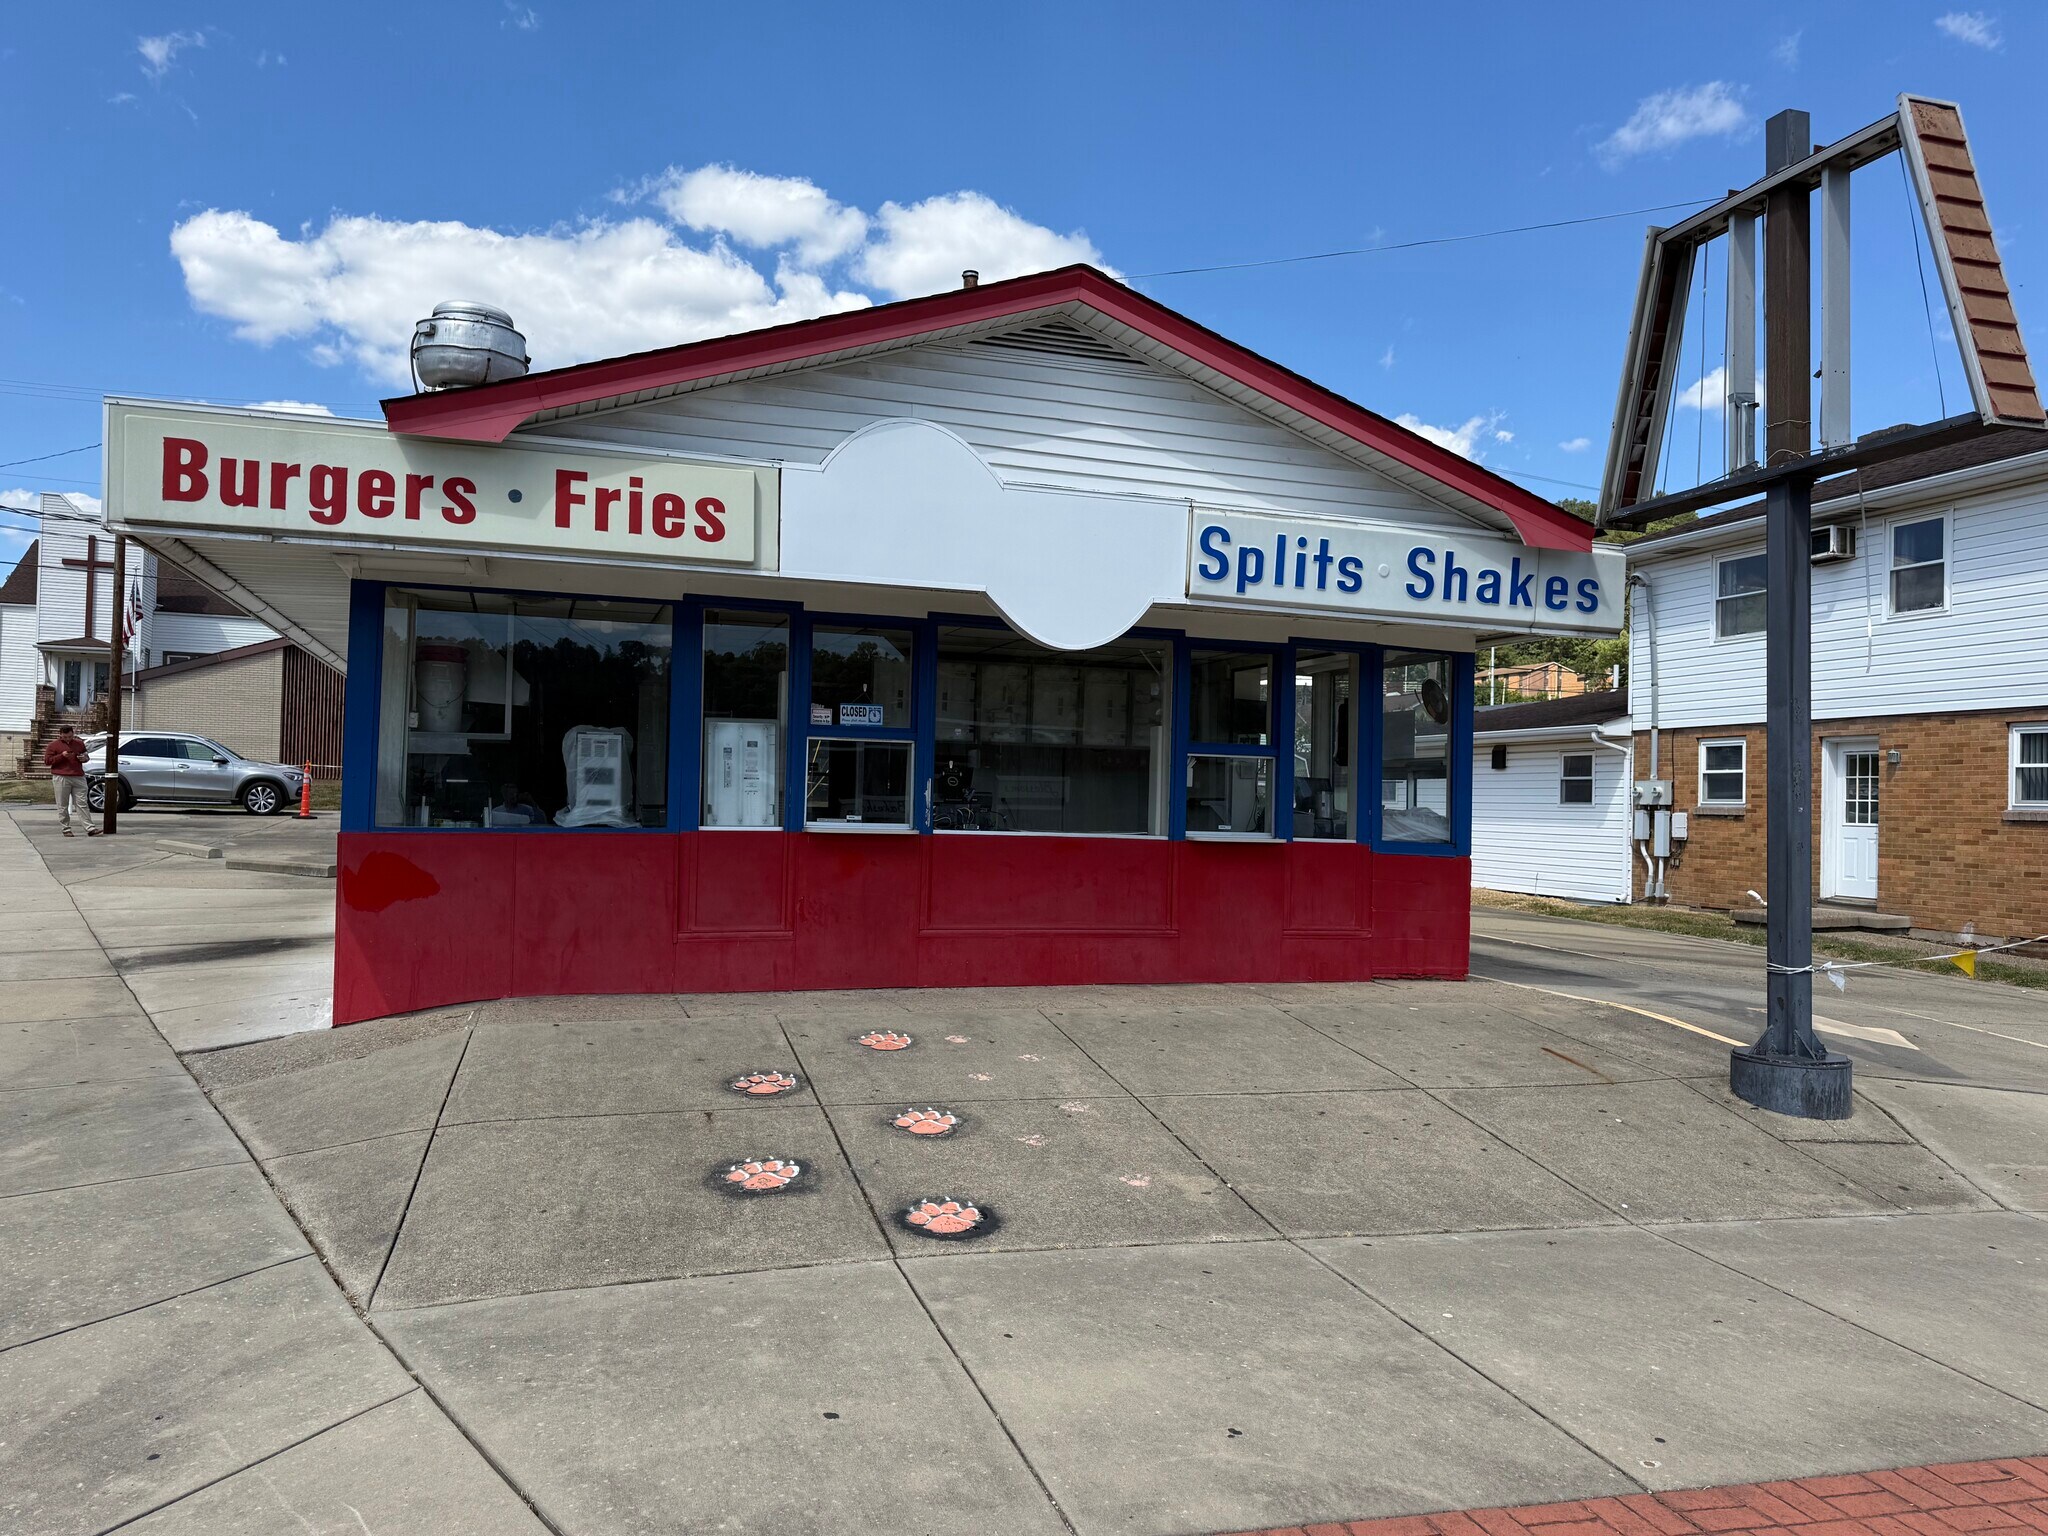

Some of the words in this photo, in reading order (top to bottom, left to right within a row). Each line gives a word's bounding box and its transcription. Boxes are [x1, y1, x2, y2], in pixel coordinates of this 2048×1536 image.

[162, 437, 477, 526] Burgers
[554, 469, 726, 543] Fries
[1198, 525, 1363, 595] Splits
[1406, 546, 1600, 613] Shakes
[841, 706, 867, 717] CLOSED
